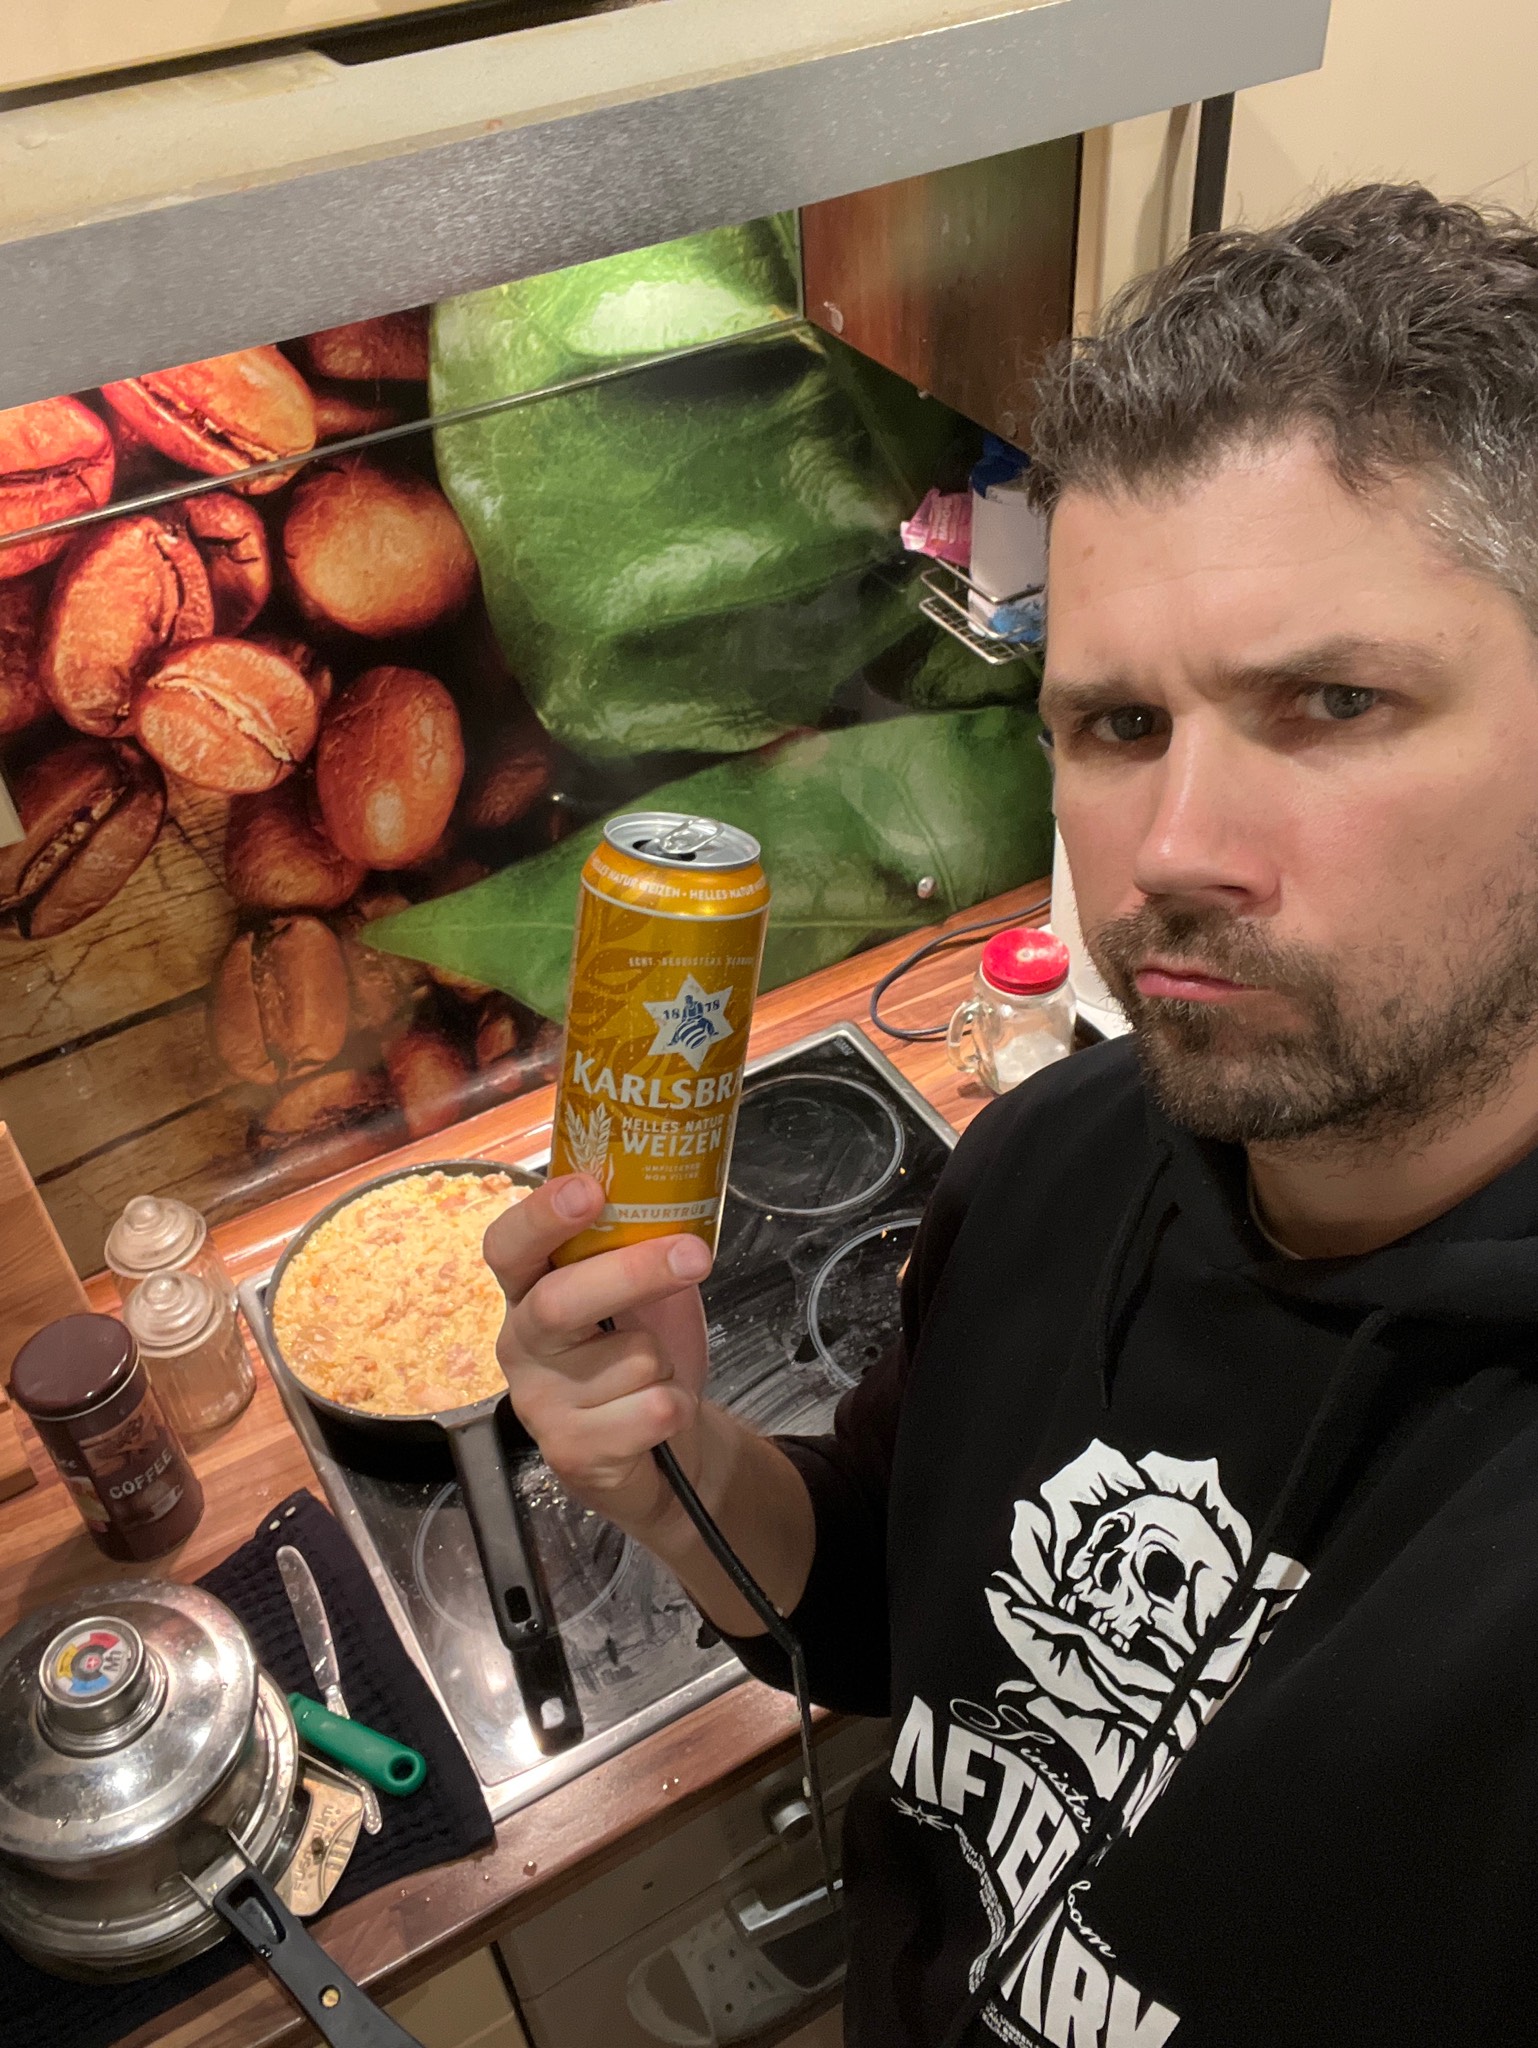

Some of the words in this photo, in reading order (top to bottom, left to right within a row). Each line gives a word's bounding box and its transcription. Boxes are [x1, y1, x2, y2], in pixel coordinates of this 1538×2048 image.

[689, 888, 728, 902] HELLES
[621, 1116, 679, 1134] HELLES
[684, 1114, 725, 1133] NATUR
[621, 1127, 722, 1158] WEIZEN
[618, 1203, 706, 1219] NATURTRÜB
[109, 1447, 173, 1500] COFFEE
[950, 1696, 1094, 1834] Sinister
[1066, 1879, 1117, 1959] loom
